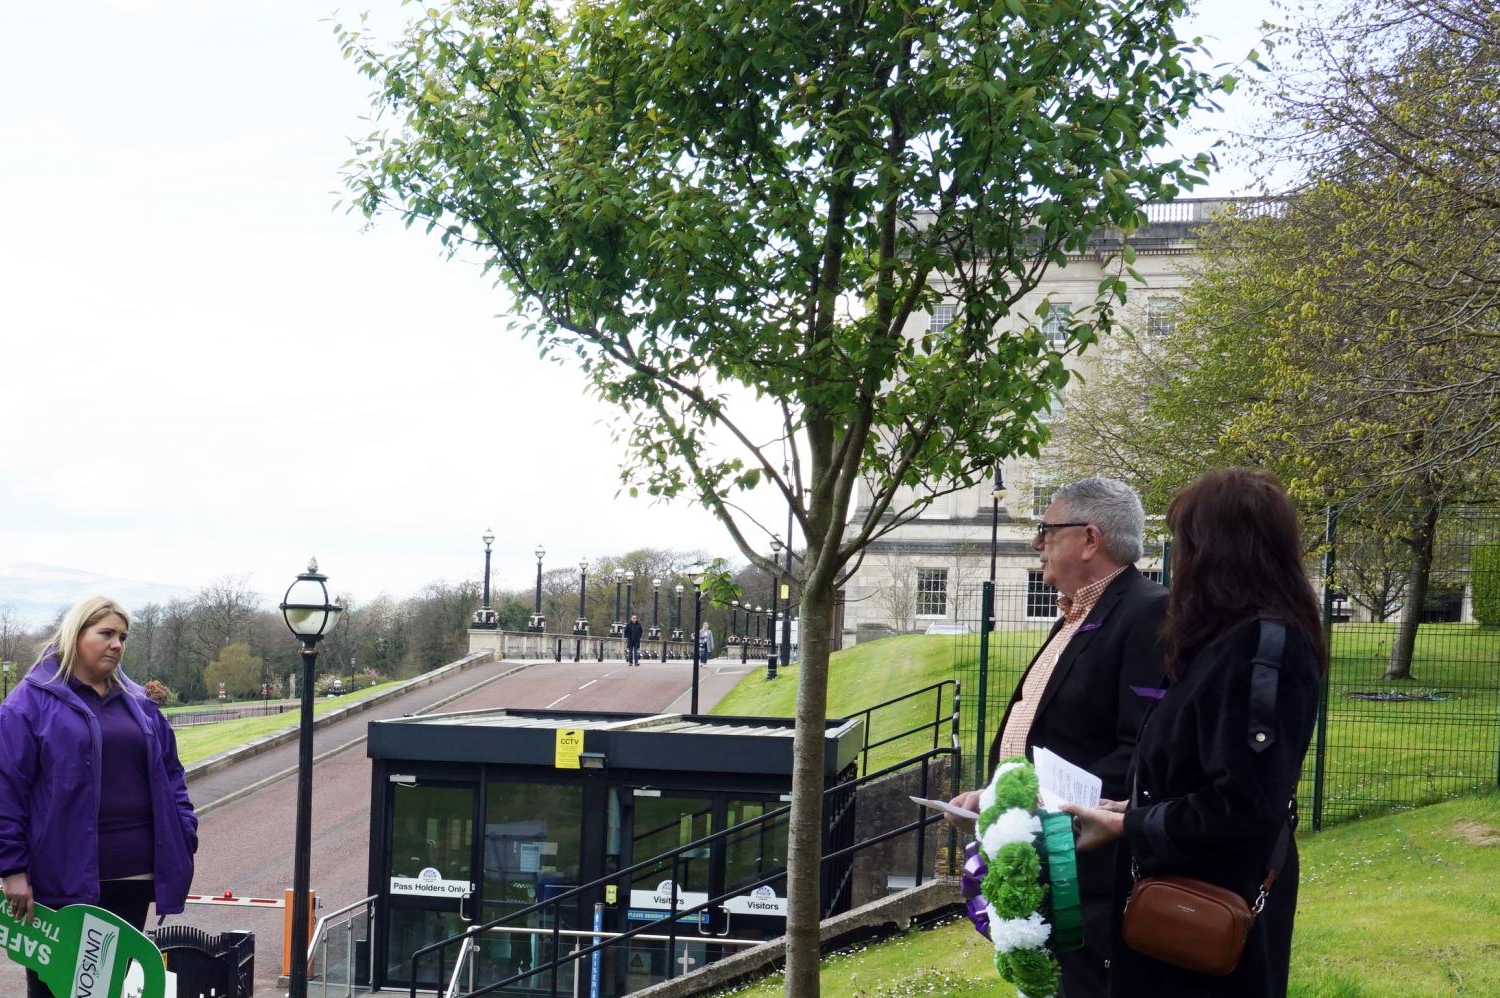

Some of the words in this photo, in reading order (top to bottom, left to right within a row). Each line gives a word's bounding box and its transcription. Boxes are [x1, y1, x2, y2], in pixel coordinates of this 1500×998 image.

[393, 882, 413, 891] Pass
[415, 883, 446, 893] Holders
[653, 895, 685, 905] Visitrs
[747, 901, 780, 911] Visitors
[31, 917, 60, 942] The
